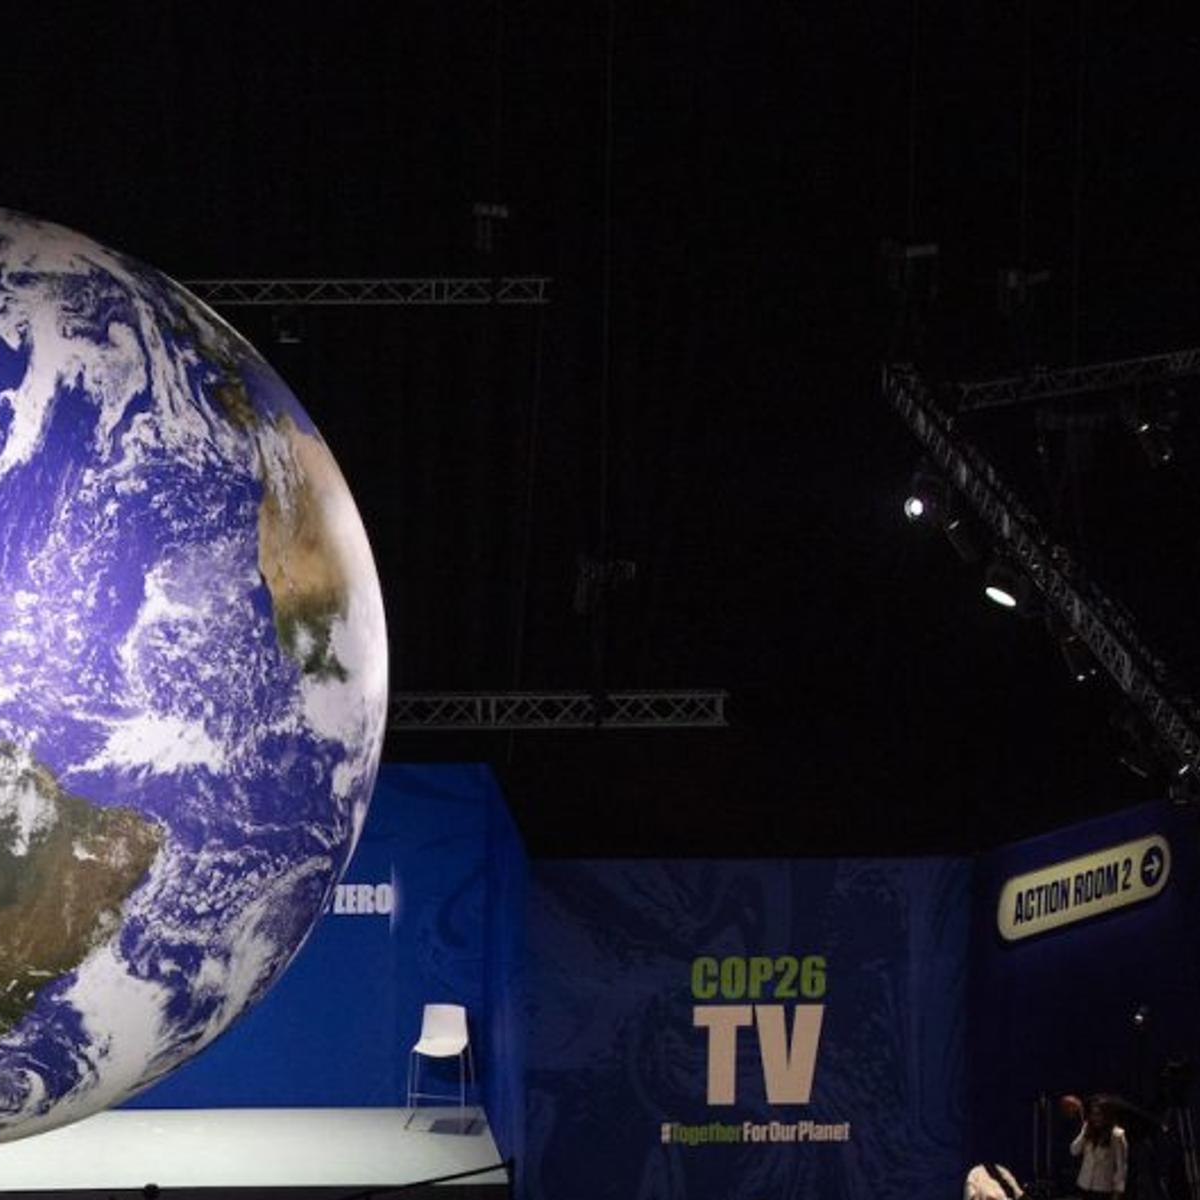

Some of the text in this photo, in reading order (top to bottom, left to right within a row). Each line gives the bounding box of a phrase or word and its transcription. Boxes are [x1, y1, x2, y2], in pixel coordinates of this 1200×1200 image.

[333, 883, 392, 915] ZERO
[1013, 858, 1132, 925] ACTION ROOM 2
[691, 955, 827, 999] COP26
[693, 1004, 824, 1106] TV
[661, 1120, 850, 1146] #TogetherForOurPlanet
